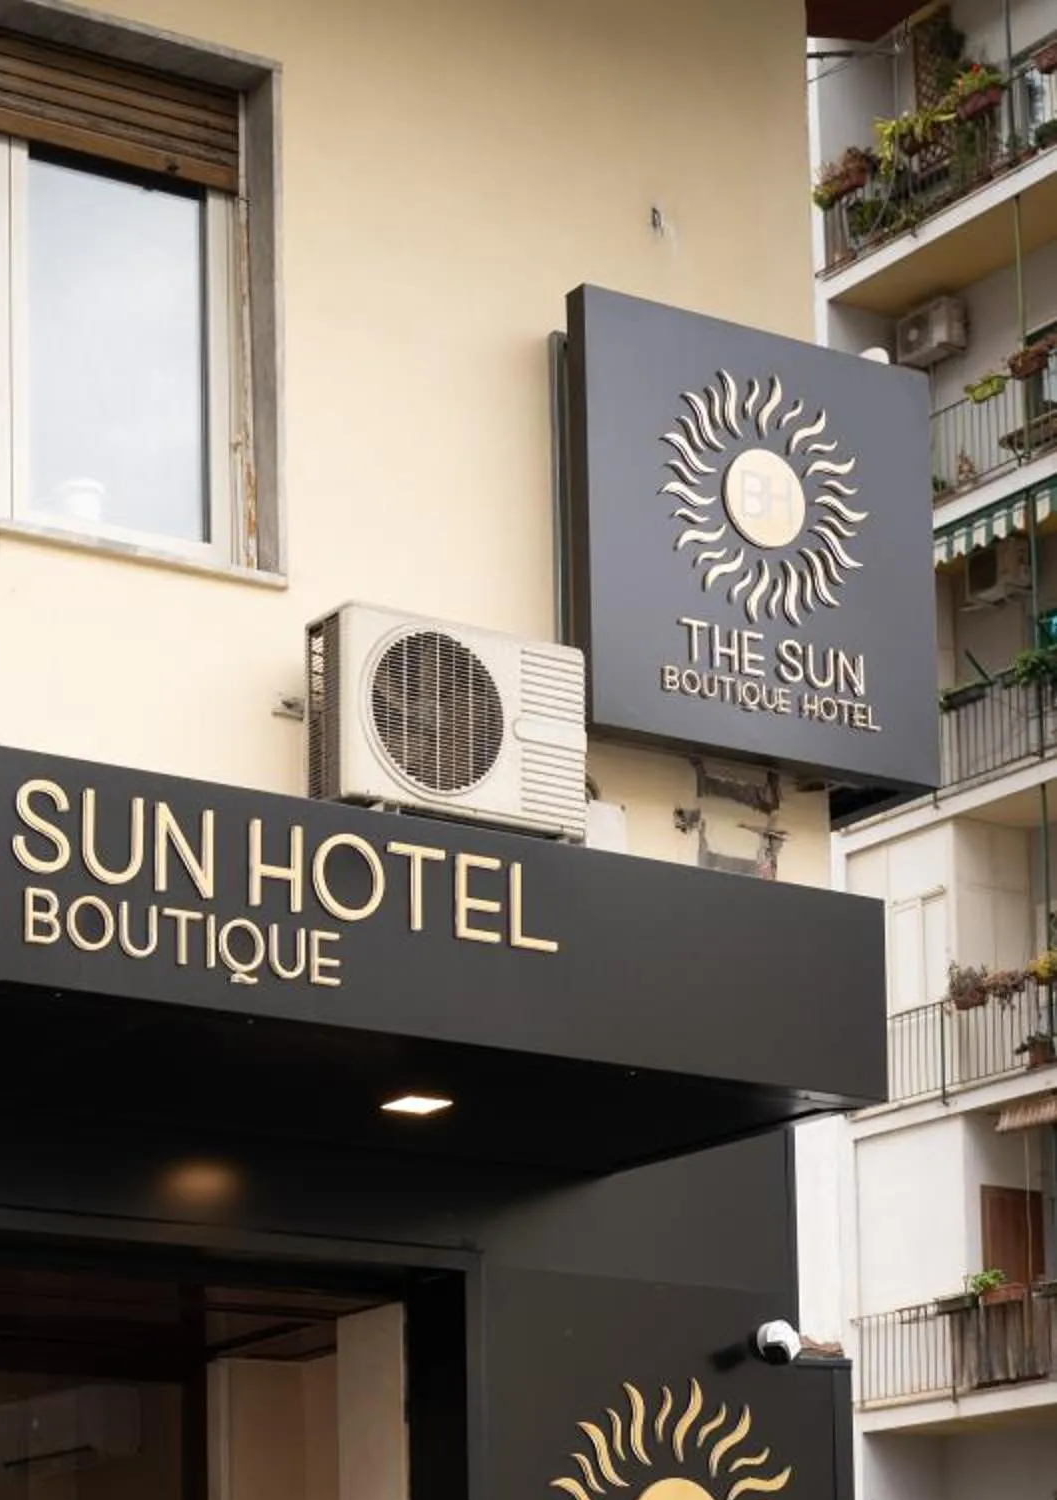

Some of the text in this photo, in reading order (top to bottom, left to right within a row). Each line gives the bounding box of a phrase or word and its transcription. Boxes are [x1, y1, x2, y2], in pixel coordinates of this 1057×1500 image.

[661, 665, 882, 732] BOUTIQUE HOTEL
[677, 617, 865, 697] THE SUN
[12, 779, 215, 899] SUN
[249, 818, 559, 952] HOTEL
[24, 886, 341, 986] BOUTIQUE
